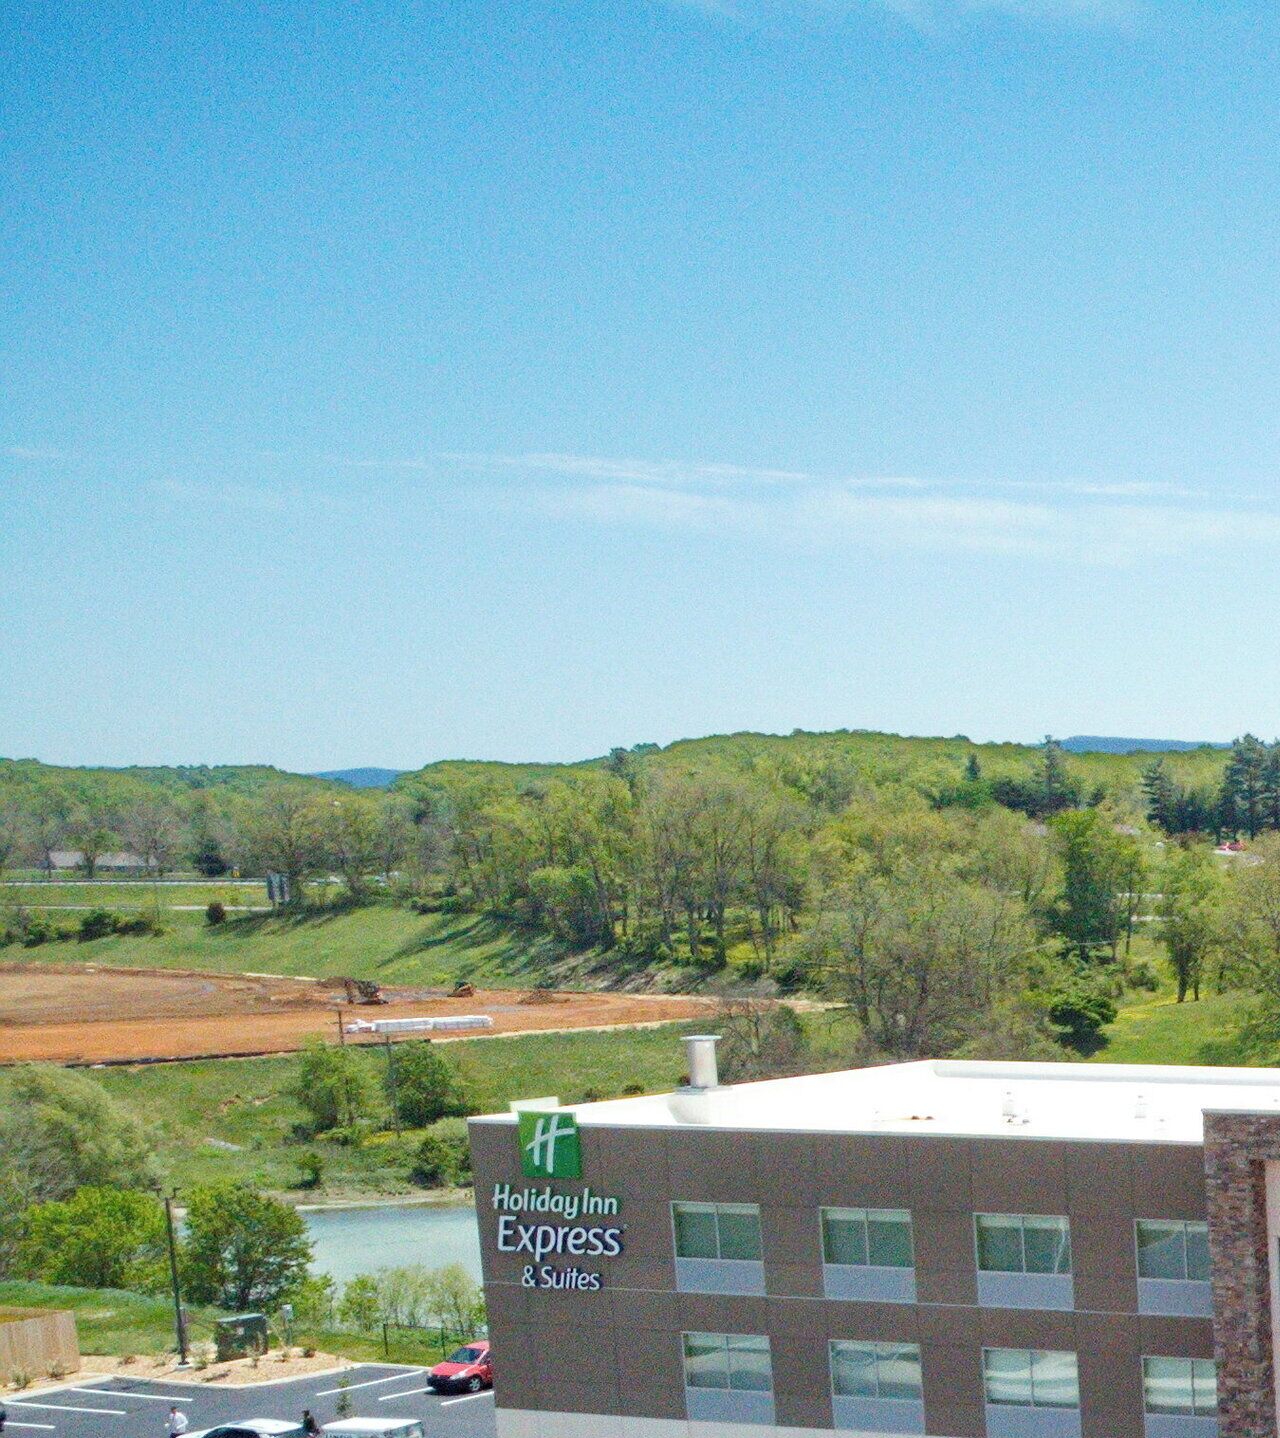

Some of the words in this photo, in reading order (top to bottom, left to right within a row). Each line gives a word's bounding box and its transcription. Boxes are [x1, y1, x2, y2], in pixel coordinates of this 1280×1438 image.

[492, 1184, 579, 1219] Holiday
[582, 1187, 618, 1215] Inn
[497, 1215, 621, 1263] Express
[522, 1265, 536, 1287] &
[541, 1265, 600, 1291] Suites
